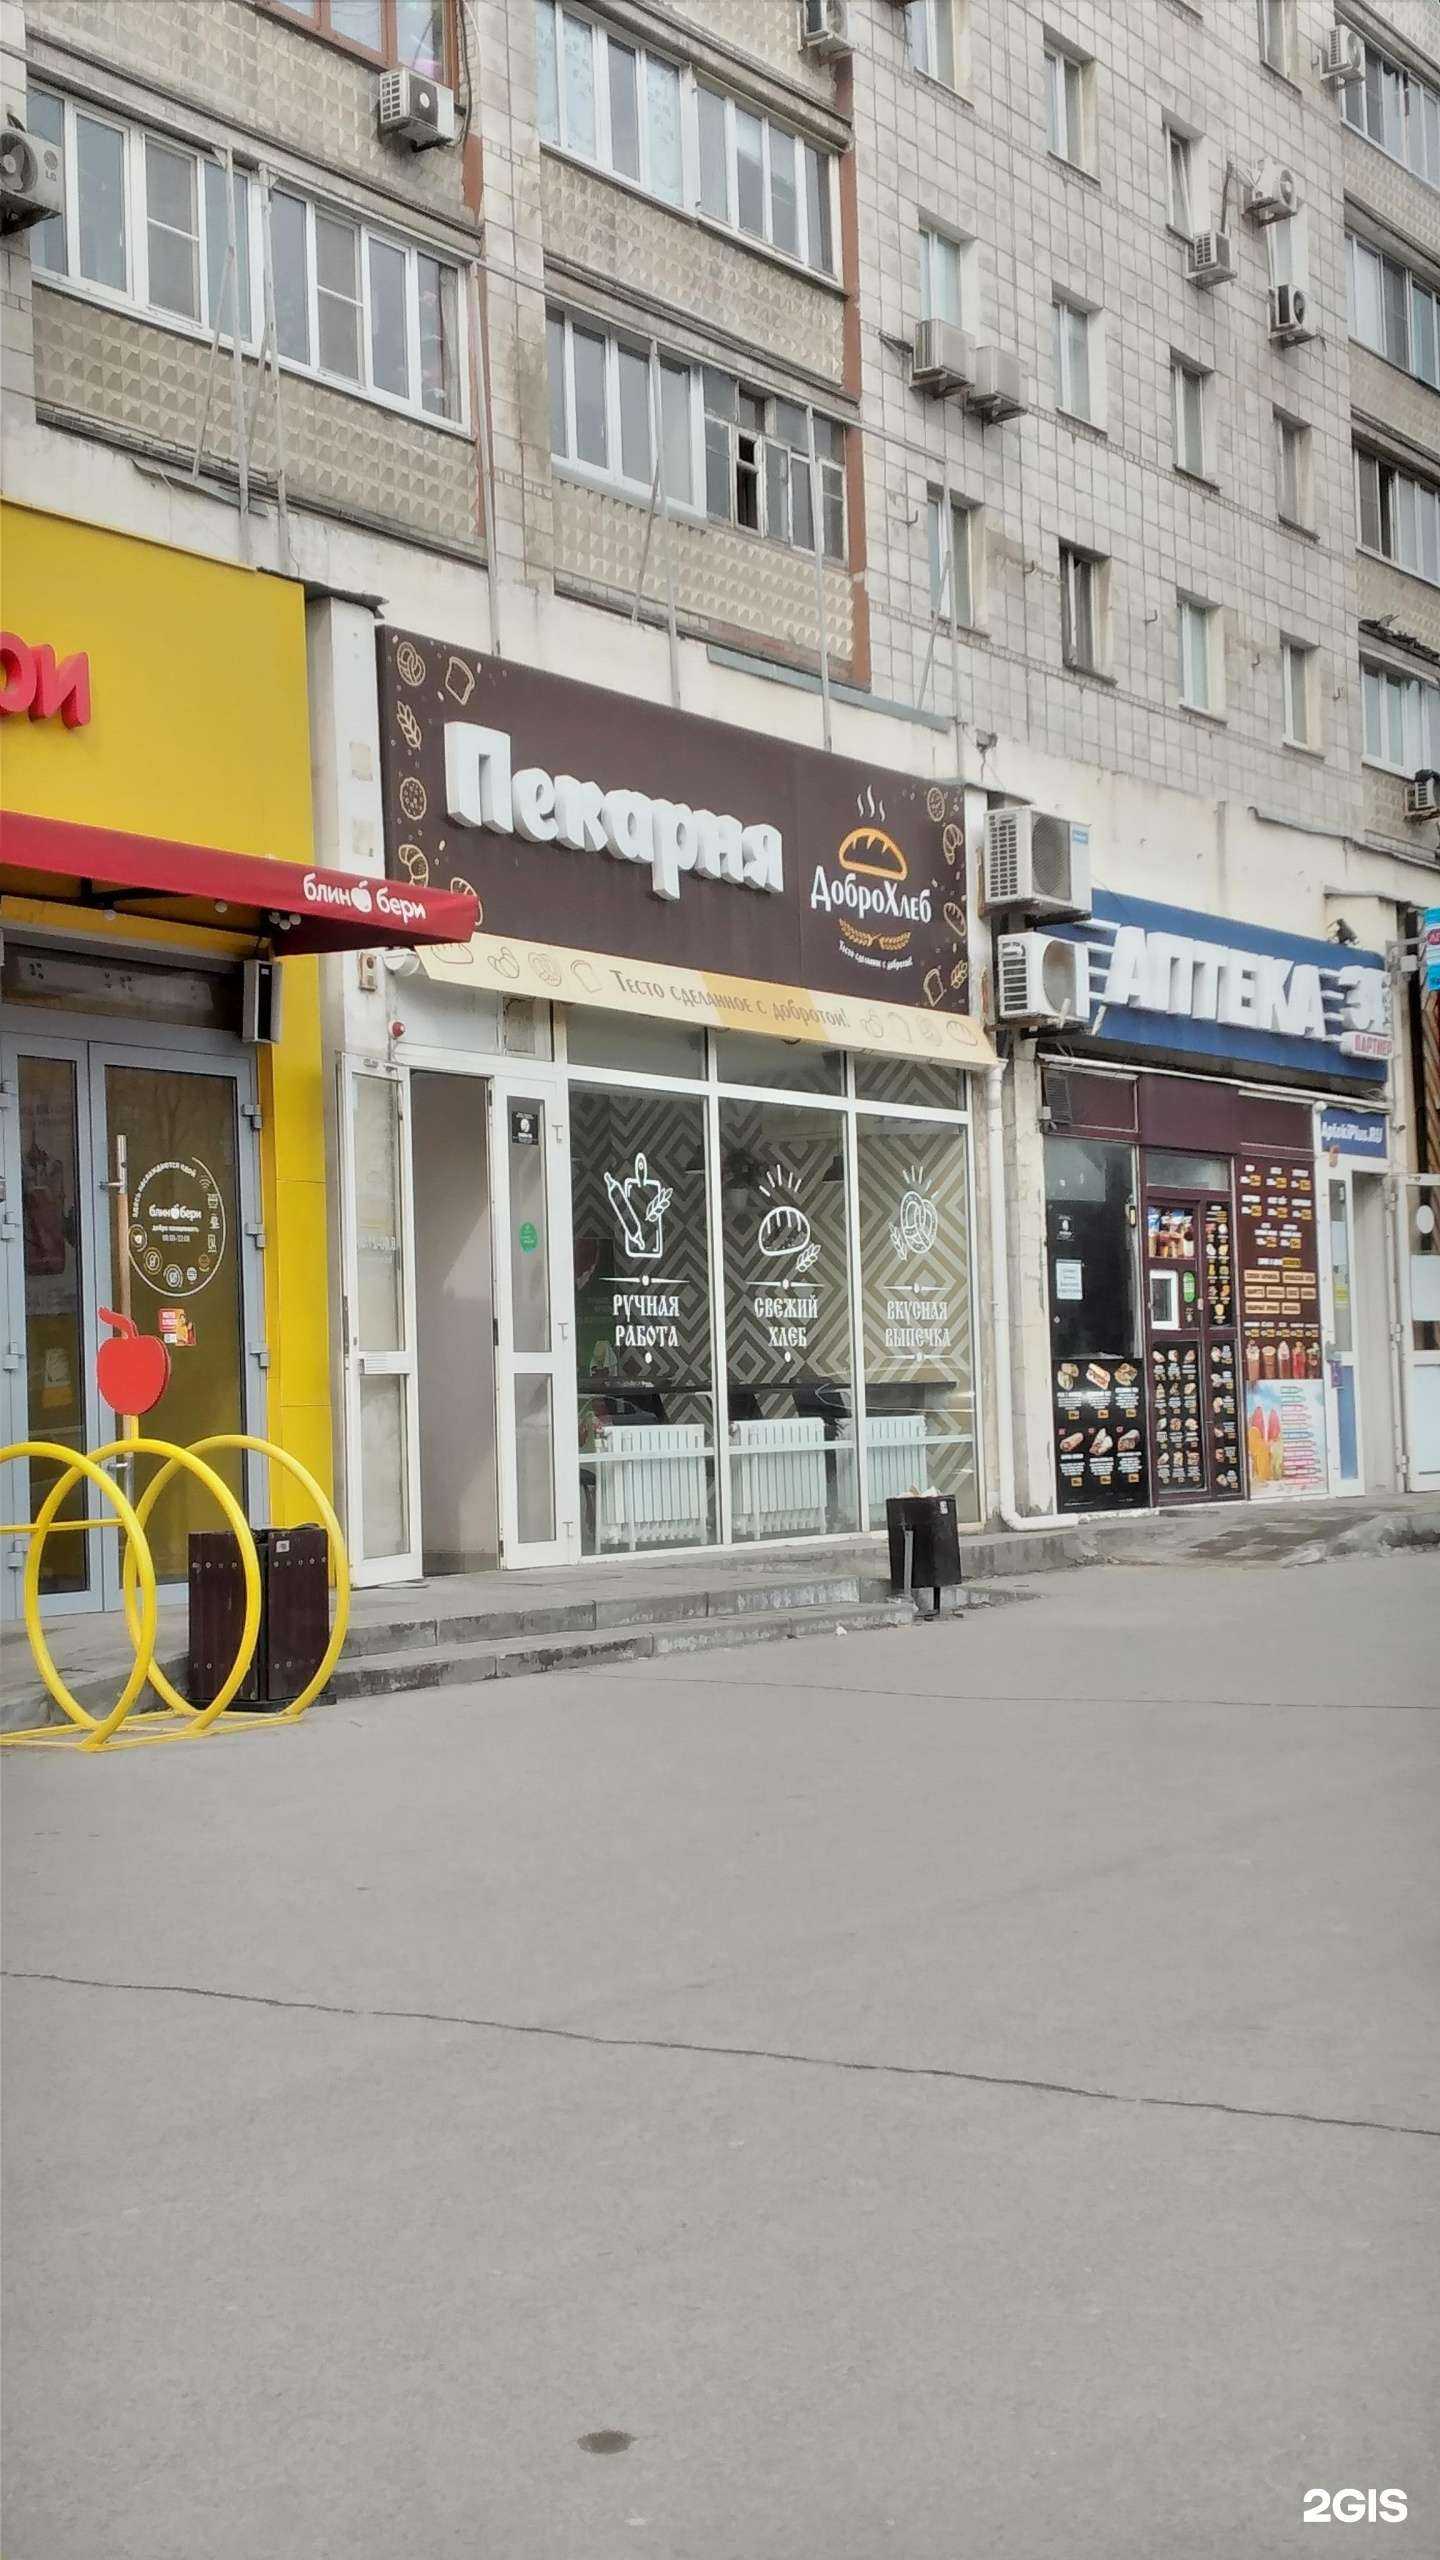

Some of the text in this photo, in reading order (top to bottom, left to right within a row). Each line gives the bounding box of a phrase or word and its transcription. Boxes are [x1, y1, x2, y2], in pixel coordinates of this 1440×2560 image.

[444, 721, 783, 900] Пекарня
[376, 887, 427, 924] бери
[811, 865, 932, 923] ДоброХлеб
[1104, 925, 1326, 1040] АПТЕКА
[613, 1294, 680, 1323] РУЧНАЯ
[754, 1295, 818, 1319] СВЕЖИЙ
[887, 1300, 948, 1323] ВКУСНАЯ
[615, 1325, 679, 1348] РАБОТА
[768, 1326, 808, 1348] ХЛЕБ
[885, 1326, 951, 1347] ВЫПЕЧКА
